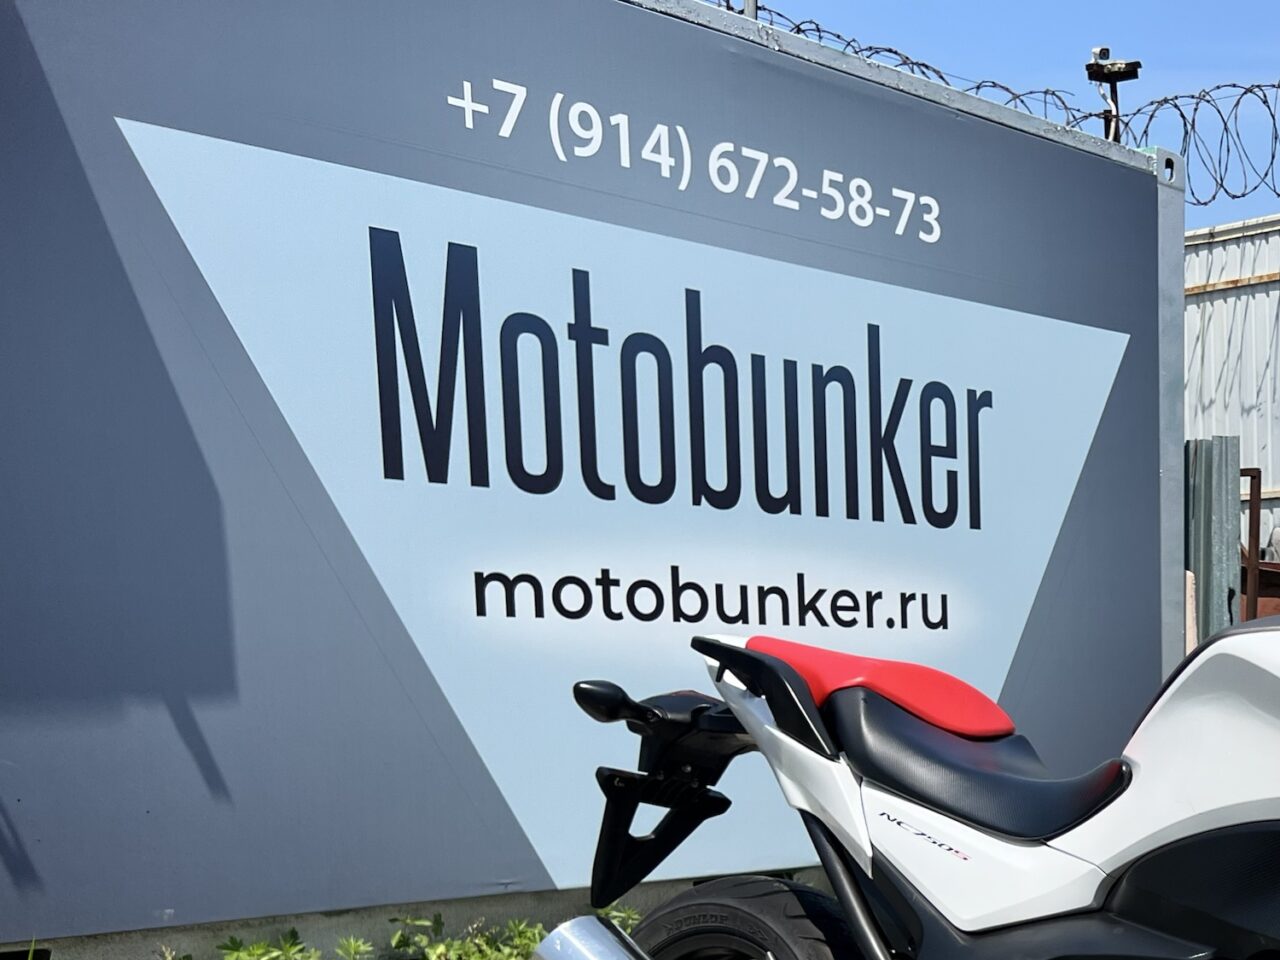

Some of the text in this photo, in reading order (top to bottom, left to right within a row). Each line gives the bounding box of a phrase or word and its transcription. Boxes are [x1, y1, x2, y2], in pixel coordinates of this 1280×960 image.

[447, 78, 942, 244] +7 (914) 672-58-73
[368, 226, 993, 531] Motobunker
[474, 565, 950, 630] motobunker.ru
[879, 811, 972, 862] NC750S
